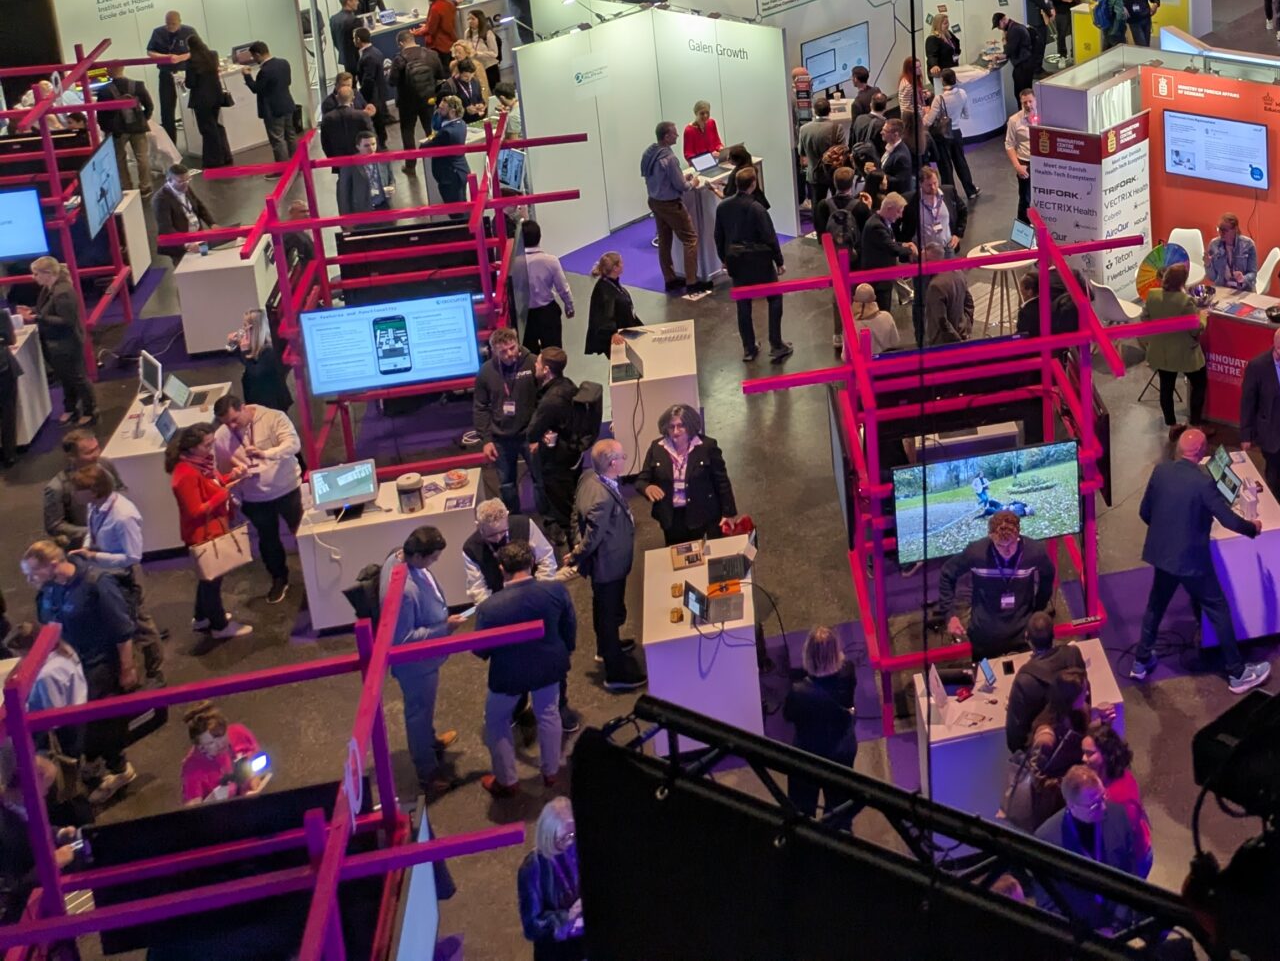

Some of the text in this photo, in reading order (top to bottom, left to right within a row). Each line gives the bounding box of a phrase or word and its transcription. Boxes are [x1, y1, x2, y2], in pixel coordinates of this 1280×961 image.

[98, 3, 122, 12] Institut
[100, 12, 117, 20] Ecole
[136, 3, 154, 12] Santé
[688, 38, 748, 60] Galen Growth
[1128, 147, 1141, 159] Danish
[1034, 169, 1066, 178] Health-Tech
[1068, 165, 1086, 173] Danish
[1103, 189, 1132, 209] VECTRIX
[1132, 184, 1148, 197] Health
[1033, 200, 1097, 217] VECTRIX Health
[1114, 251, 1133, 265] Teton
[1206, 362, 1242, 377] CENTRE
